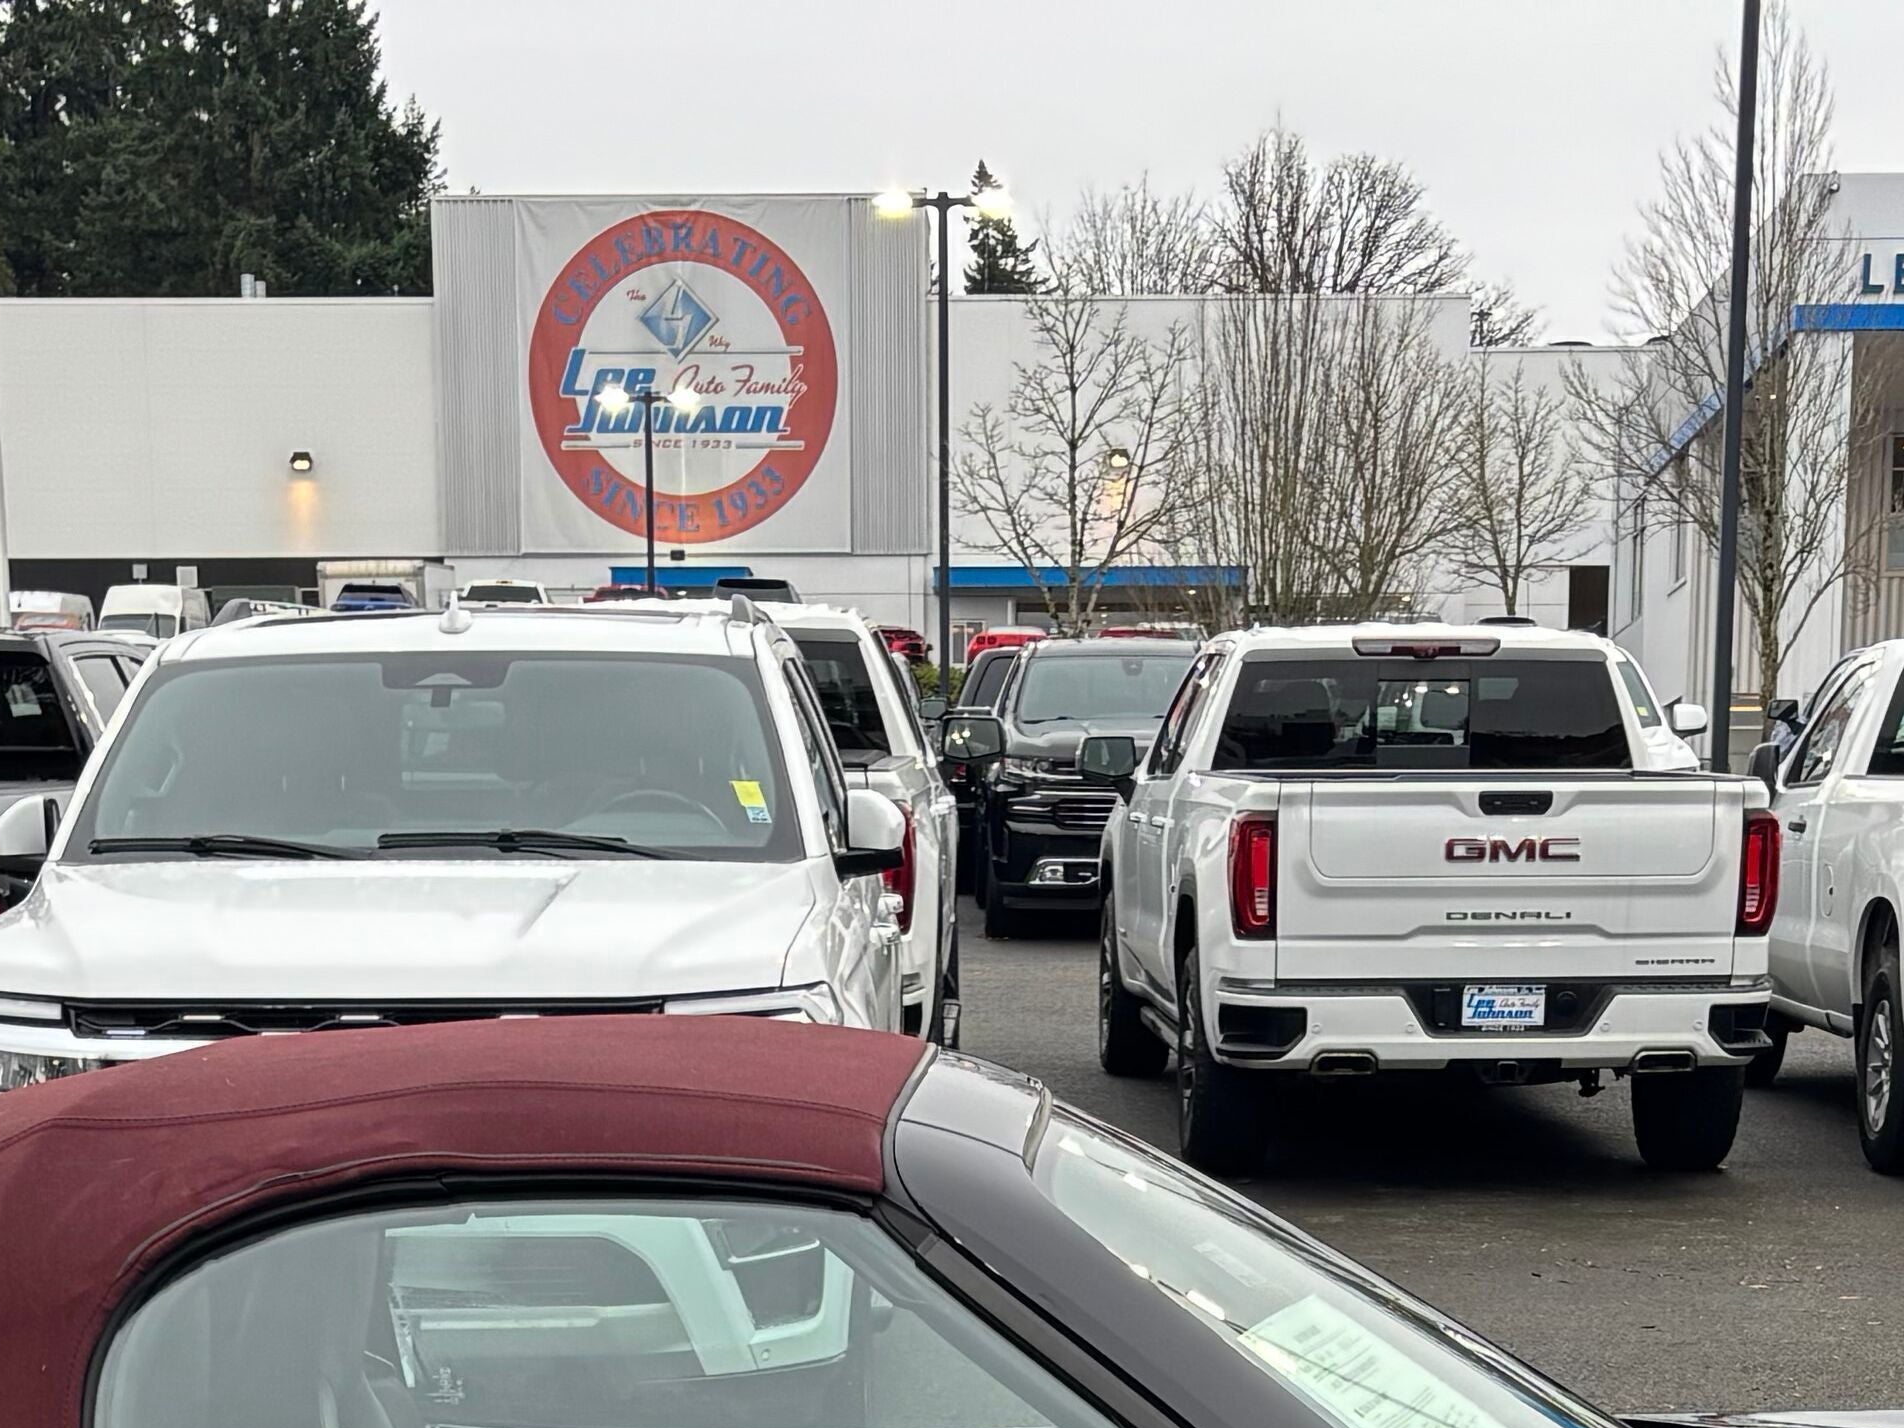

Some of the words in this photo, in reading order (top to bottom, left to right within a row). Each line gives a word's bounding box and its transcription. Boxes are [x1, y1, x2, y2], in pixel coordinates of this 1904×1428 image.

[552, 221, 813, 325] CELEBRATING
[559, 347, 657, 397] Lee
[730, 363, 807, 410] Family
[633, 439, 682, 450] SNCE
[691, 439, 733, 450] 1933
[712, 465, 785, 527] 1933
[1445, 836, 1581, 863] GMC
[1446, 911, 1572, 921] DENALI
